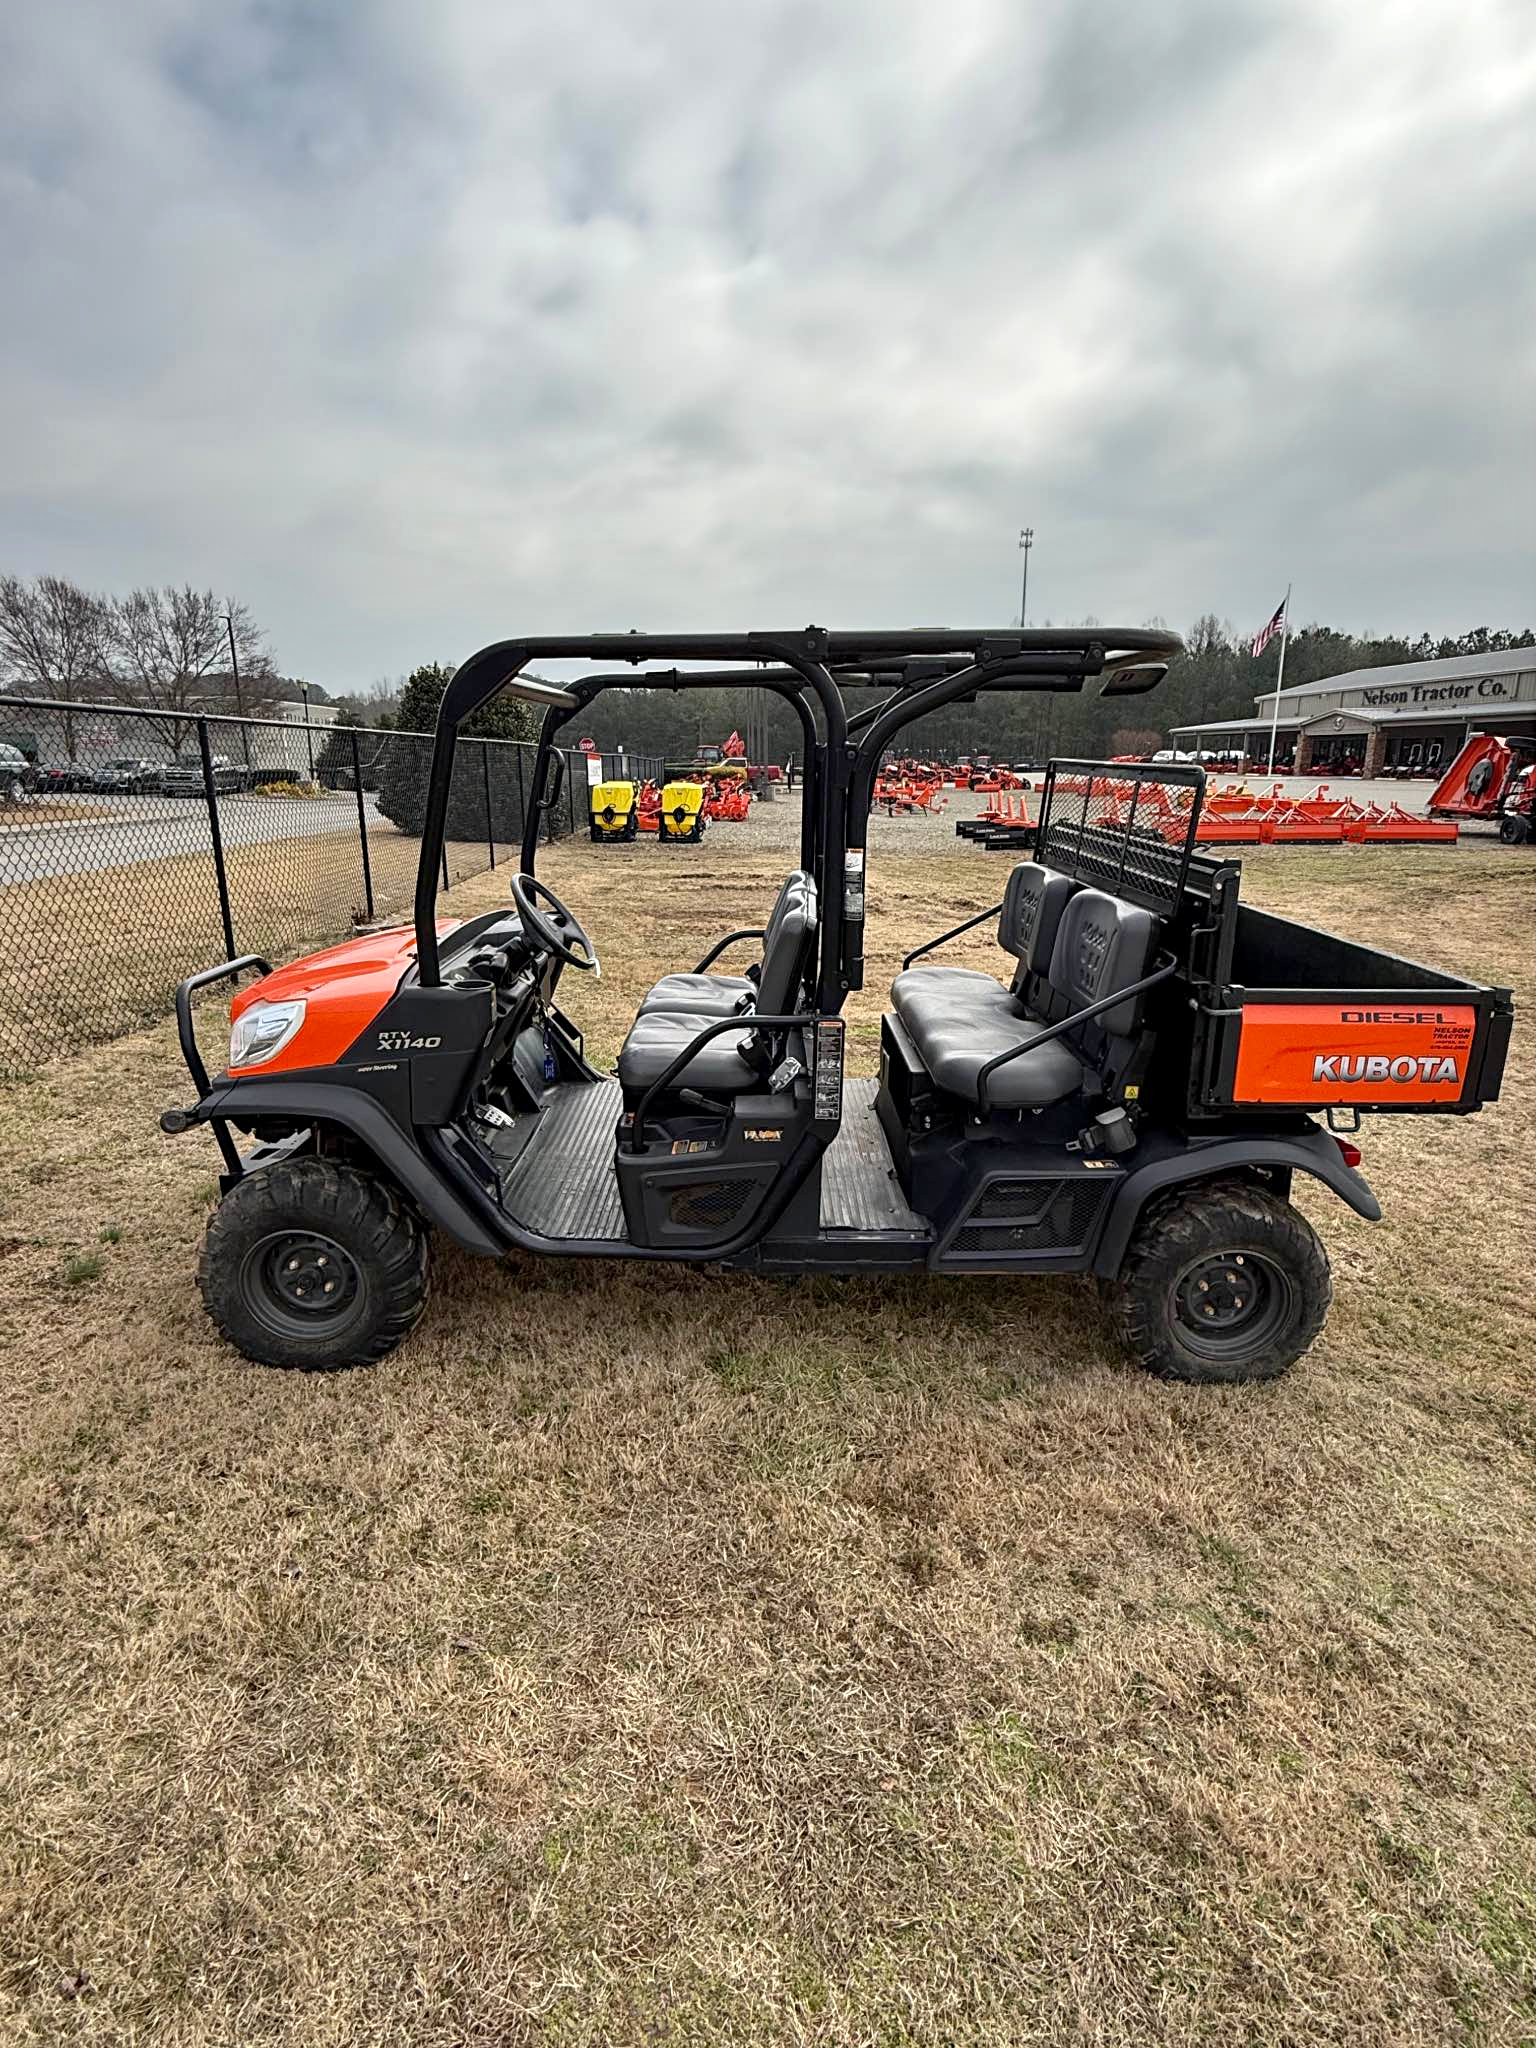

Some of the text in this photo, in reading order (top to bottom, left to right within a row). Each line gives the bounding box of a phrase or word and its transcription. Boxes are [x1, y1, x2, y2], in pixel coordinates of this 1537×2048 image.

[1361, 678, 1508, 705] Nelson Tractor Co.
[1341, 1011, 1457, 1024] DIESEL
[378, 1031, 411, 1040] RTV
[376, 1037, 442, 1051] X1140
[1312, 1055, 1460, 1084] KUBOTA
